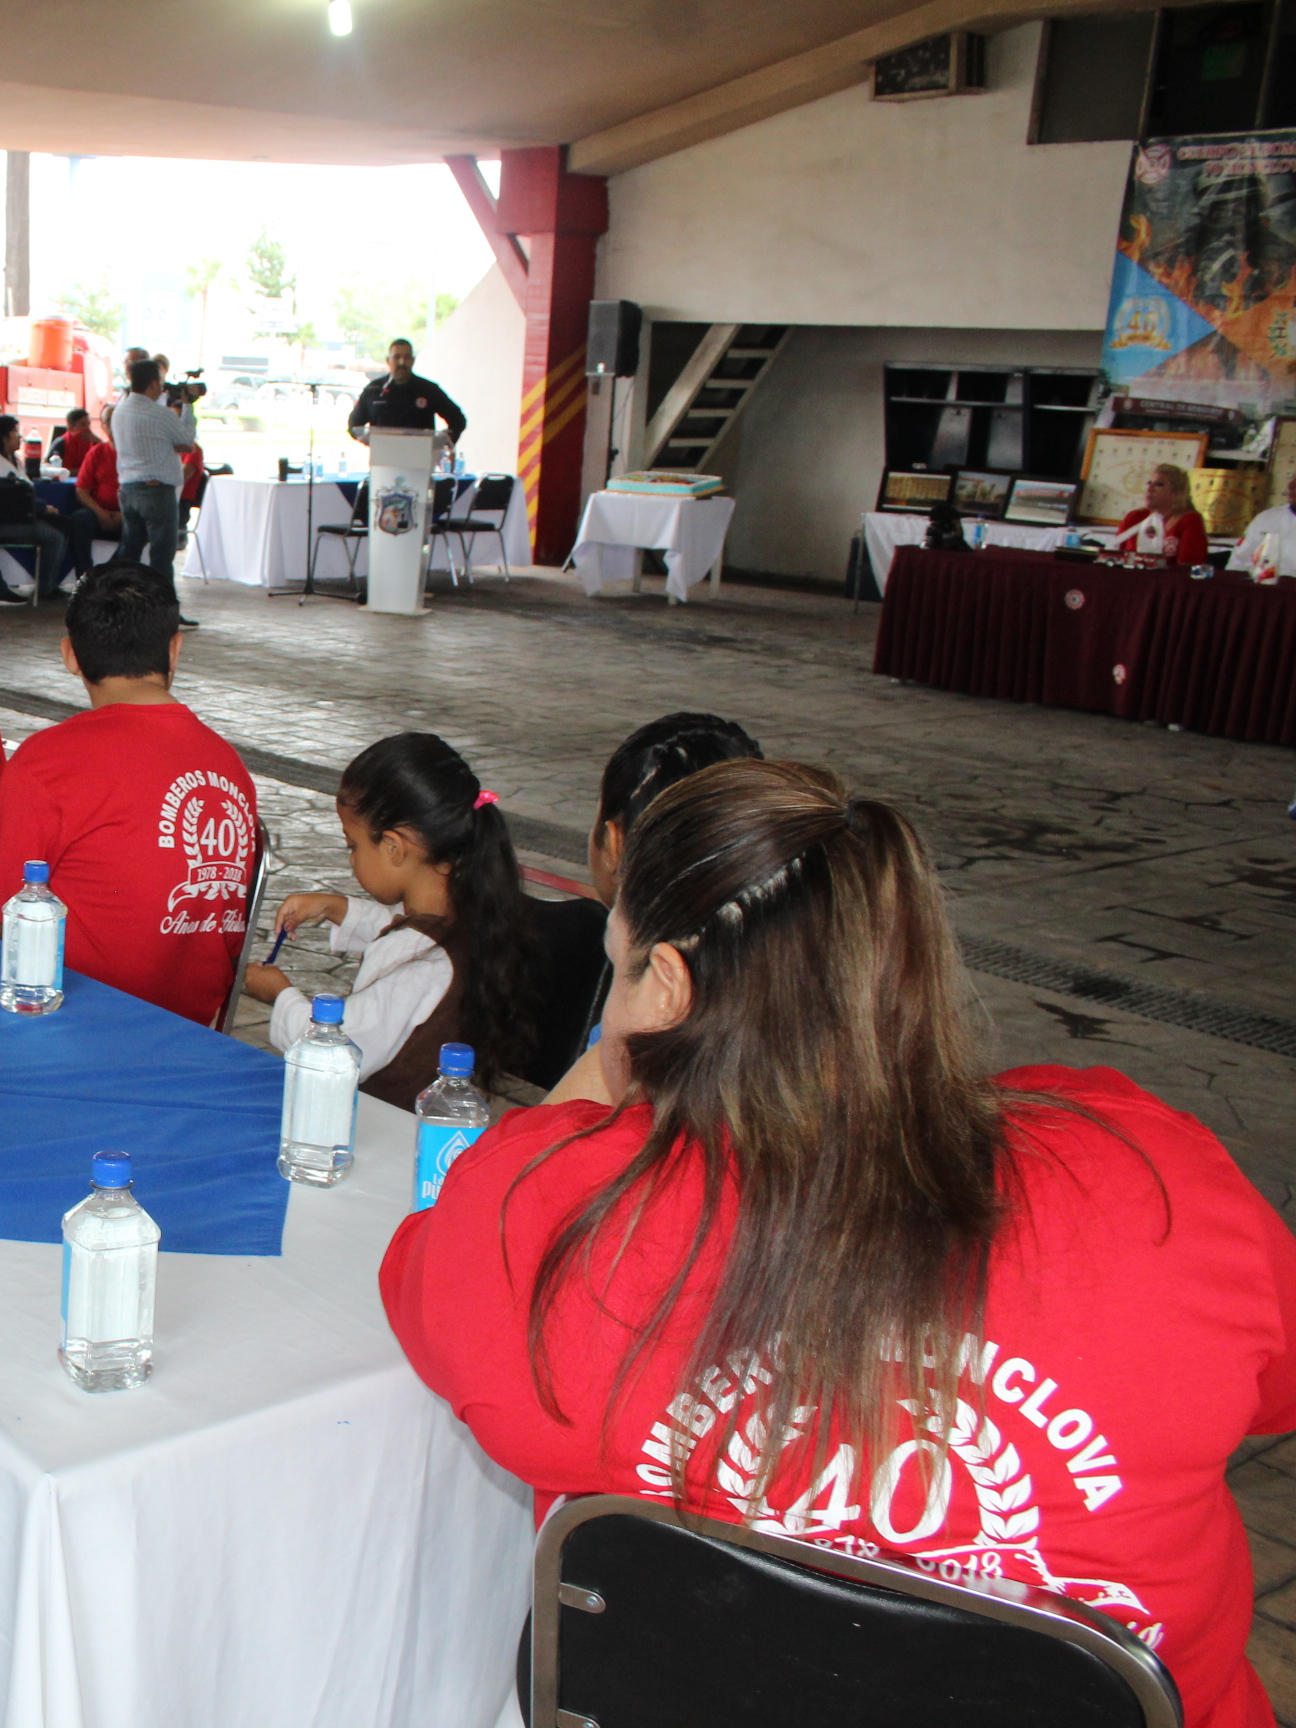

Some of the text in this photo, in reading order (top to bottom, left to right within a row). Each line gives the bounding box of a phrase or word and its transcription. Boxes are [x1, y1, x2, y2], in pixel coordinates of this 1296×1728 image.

[1127, 311, 1159, 333] 40
[158, 769, 206, 848] BOMBEROS
[200, 817, 236, 857] 40
[199, 912, 217, 933] de
[785, 1438, 953, 1544] 40
